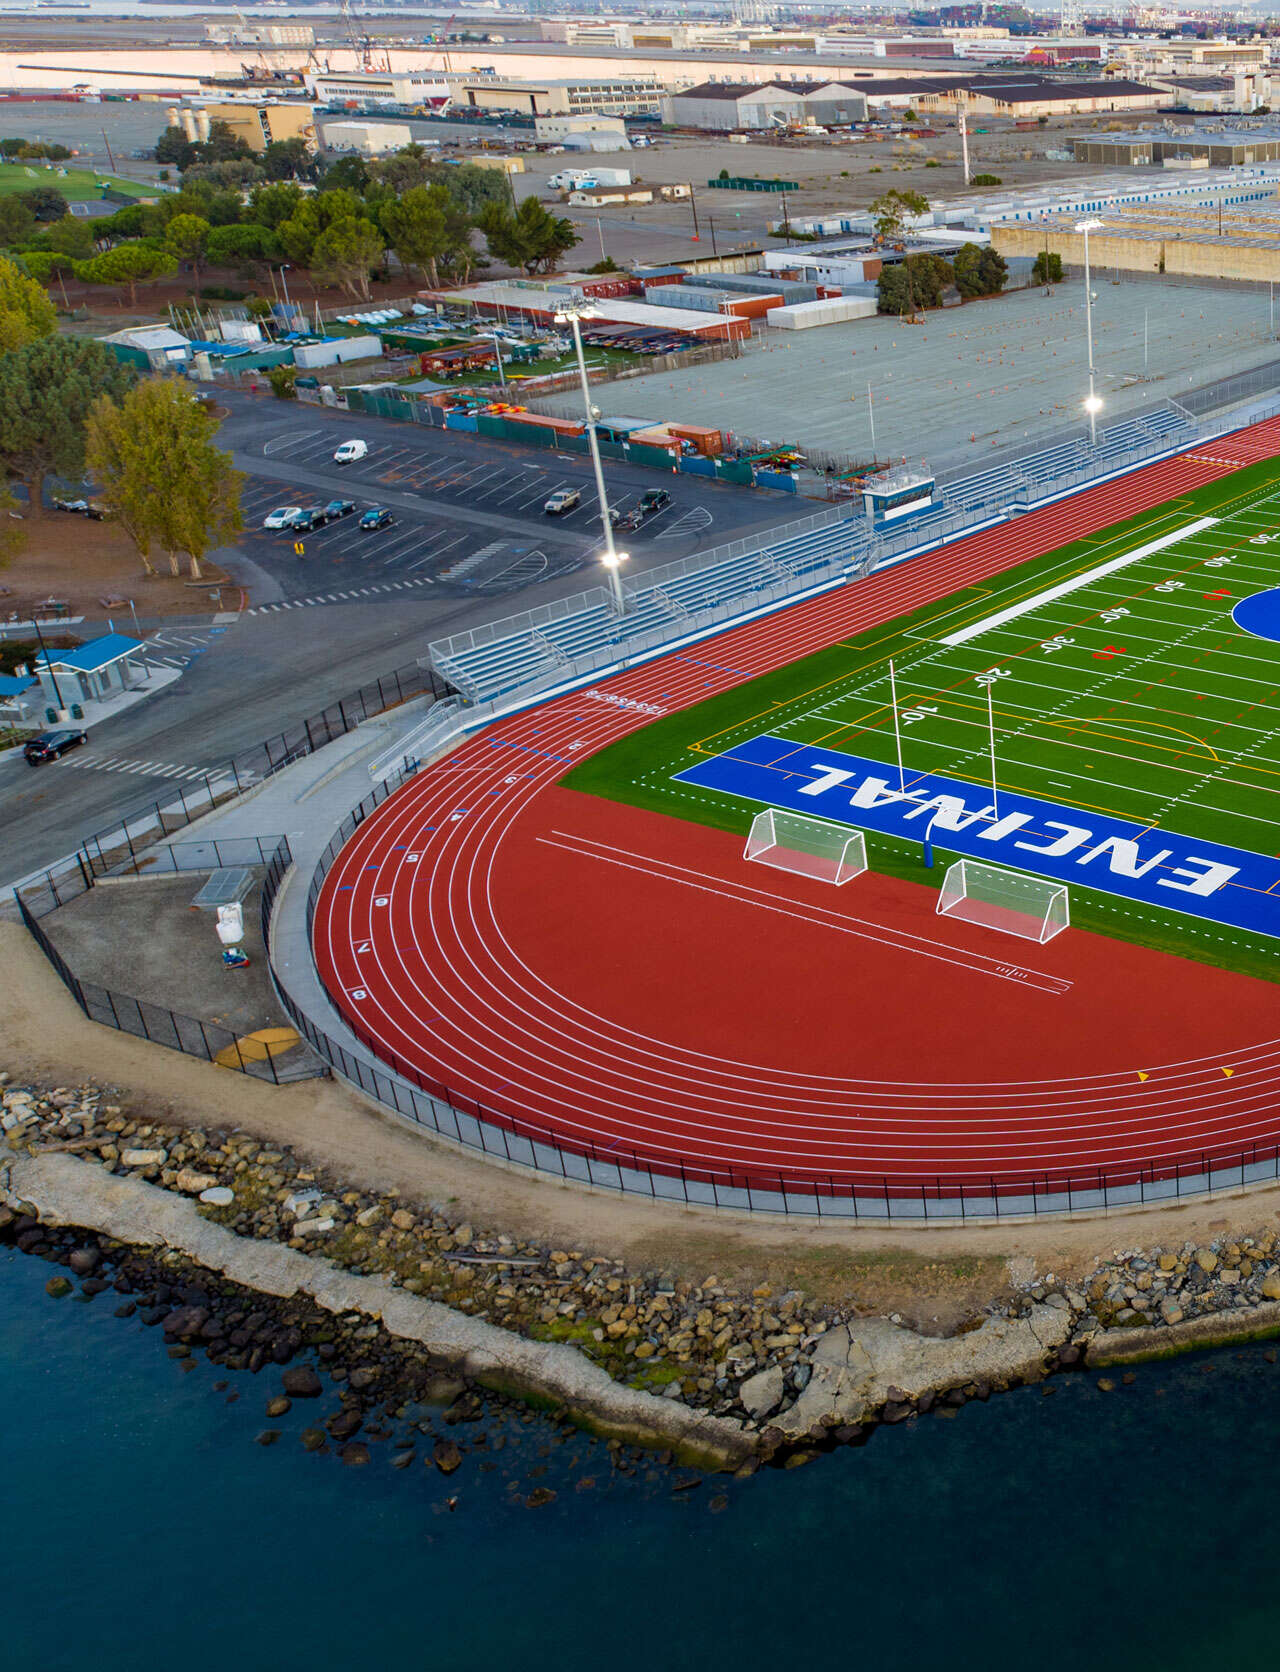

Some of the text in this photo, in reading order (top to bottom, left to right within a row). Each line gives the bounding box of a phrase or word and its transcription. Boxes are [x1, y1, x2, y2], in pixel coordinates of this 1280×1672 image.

[1154, 580, 1186, 593] 50
[1100, 607, 1131, 621] 40
[1040, 635, 1075, 651] 30
[1092, 645, 1127, 660] 20
[974, 667, 1012, 684] 20
[901, 705, 939, 722] 10
[797, 764, 1241, 897] ENCINAL
